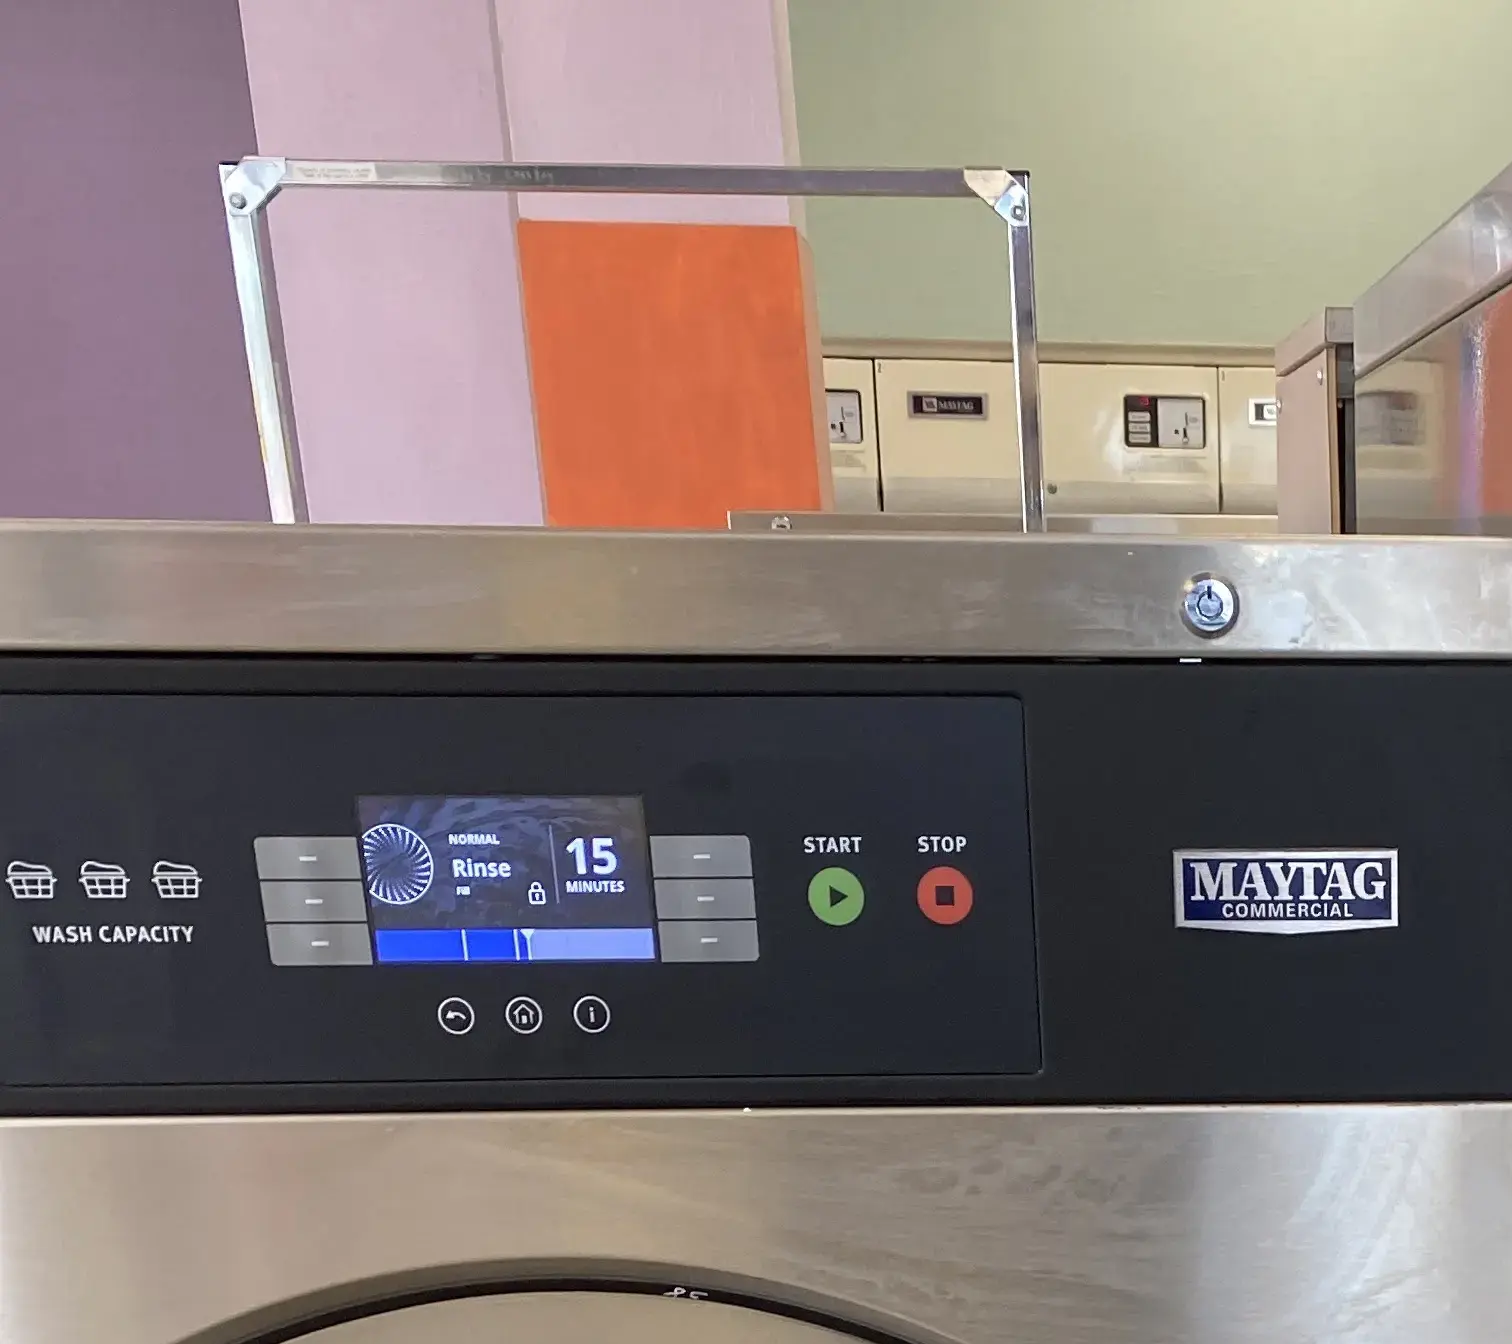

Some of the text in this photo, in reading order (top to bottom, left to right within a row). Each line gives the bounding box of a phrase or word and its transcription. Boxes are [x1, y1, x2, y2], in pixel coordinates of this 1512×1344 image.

[448, 833, 500, 846] NORMAL
[803, 836, 862, 854] START
[917, 835, 967, 853] STOP
[566, 837, 618, 876] 15
[452, 858, 512, 878] Rinse
[565, 880, 625, 893] MINUTES
[1190, 861, 1387, 901] MAYTAG
[1221, 902, 1354, 919] COMMERCIAL
[32, 925, 194, 943] WASH CAPACITY
